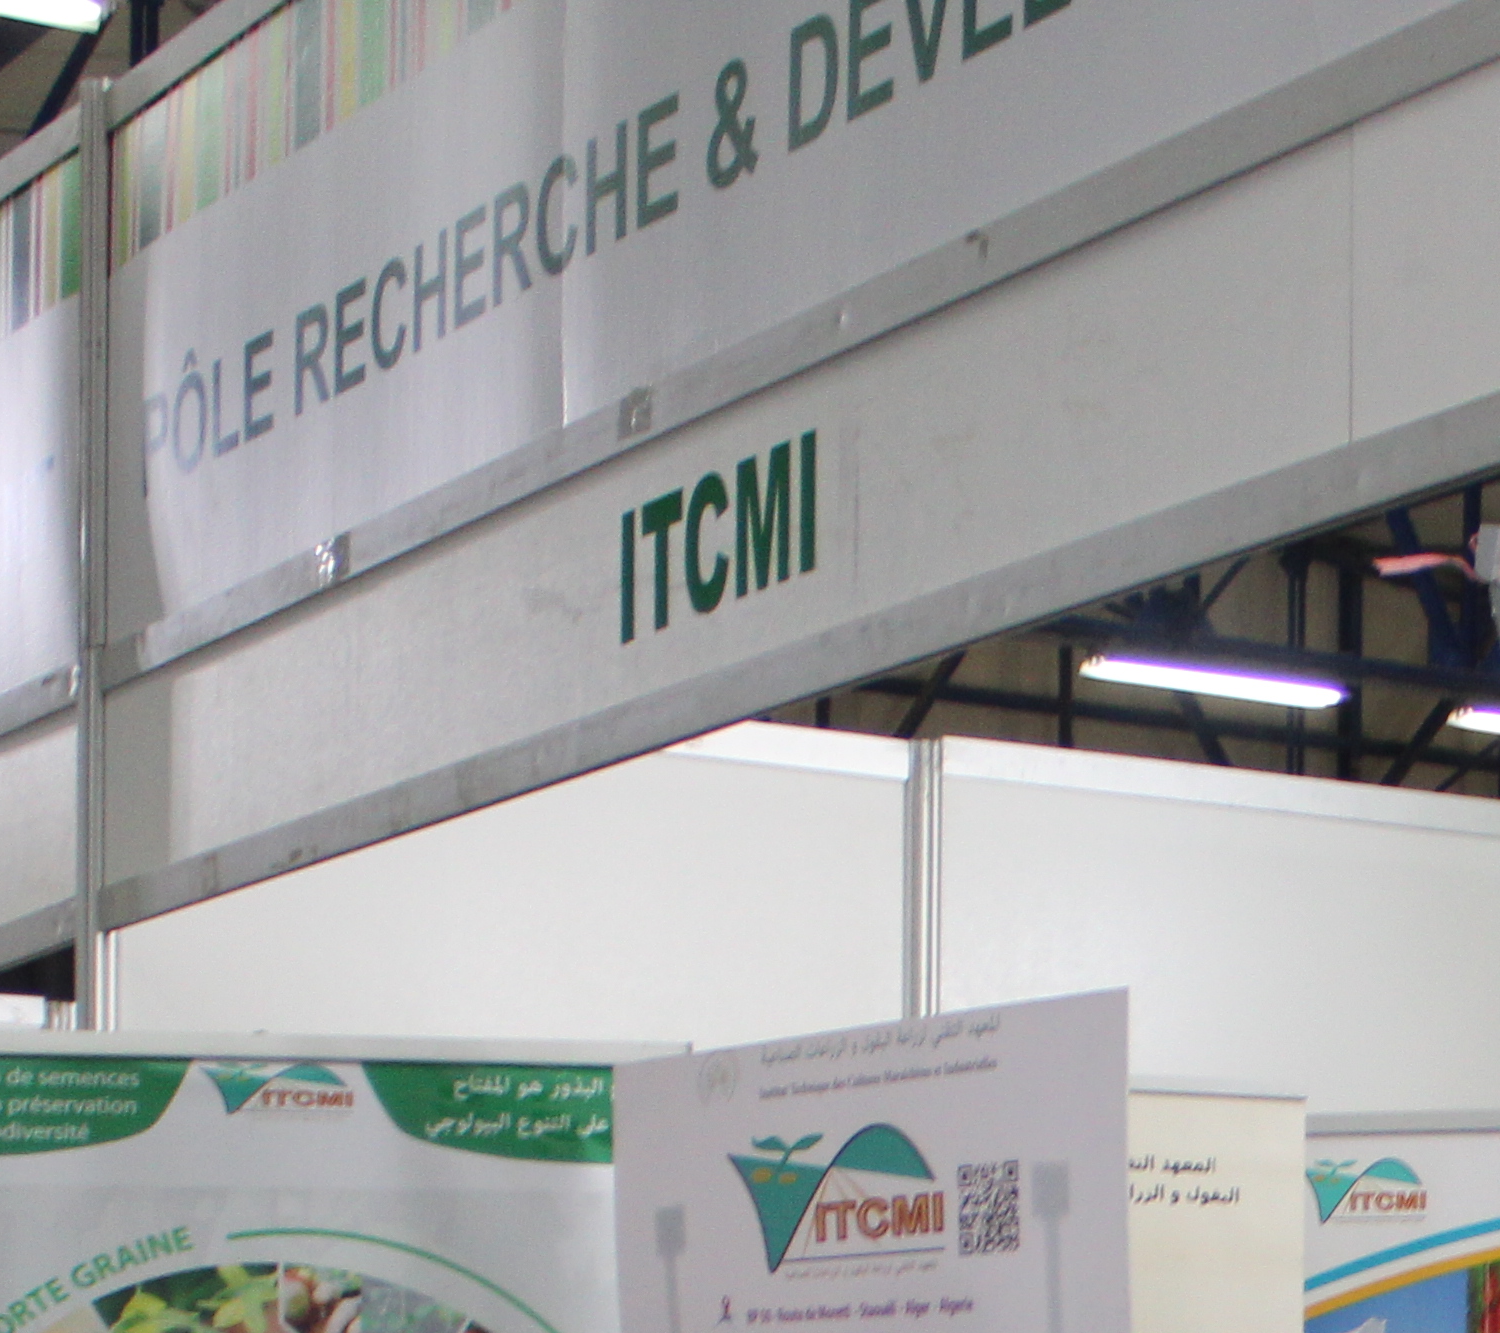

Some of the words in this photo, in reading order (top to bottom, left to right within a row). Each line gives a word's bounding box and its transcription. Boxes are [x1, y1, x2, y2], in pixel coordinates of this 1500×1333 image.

[141, 330, 274, 497] PÔLE
[295, 91, 680, 417] RECHERCHE
[707, 57, 759, 190] &
[620, 428, 818, 646] ITCMI
[5, 1067, 33, 1086] de
[38, 1070, 140, 1087] semences
[517, 1079, 543, 1098] هو
[550, 1075, 604, 1100] البذور
[7, 1094, 137, 1117] préservation
[261, 1088, 354, 1107] ITCMI
[516, 1114, 571, 1139] التنوع
[577, 1117, 609, 1142] على
[1349, 1190, 1426, 1212] ITCMI
[815, 1191, 945, 1243] ITCMI
[69, 1224, 194, 1288] GRAINE
